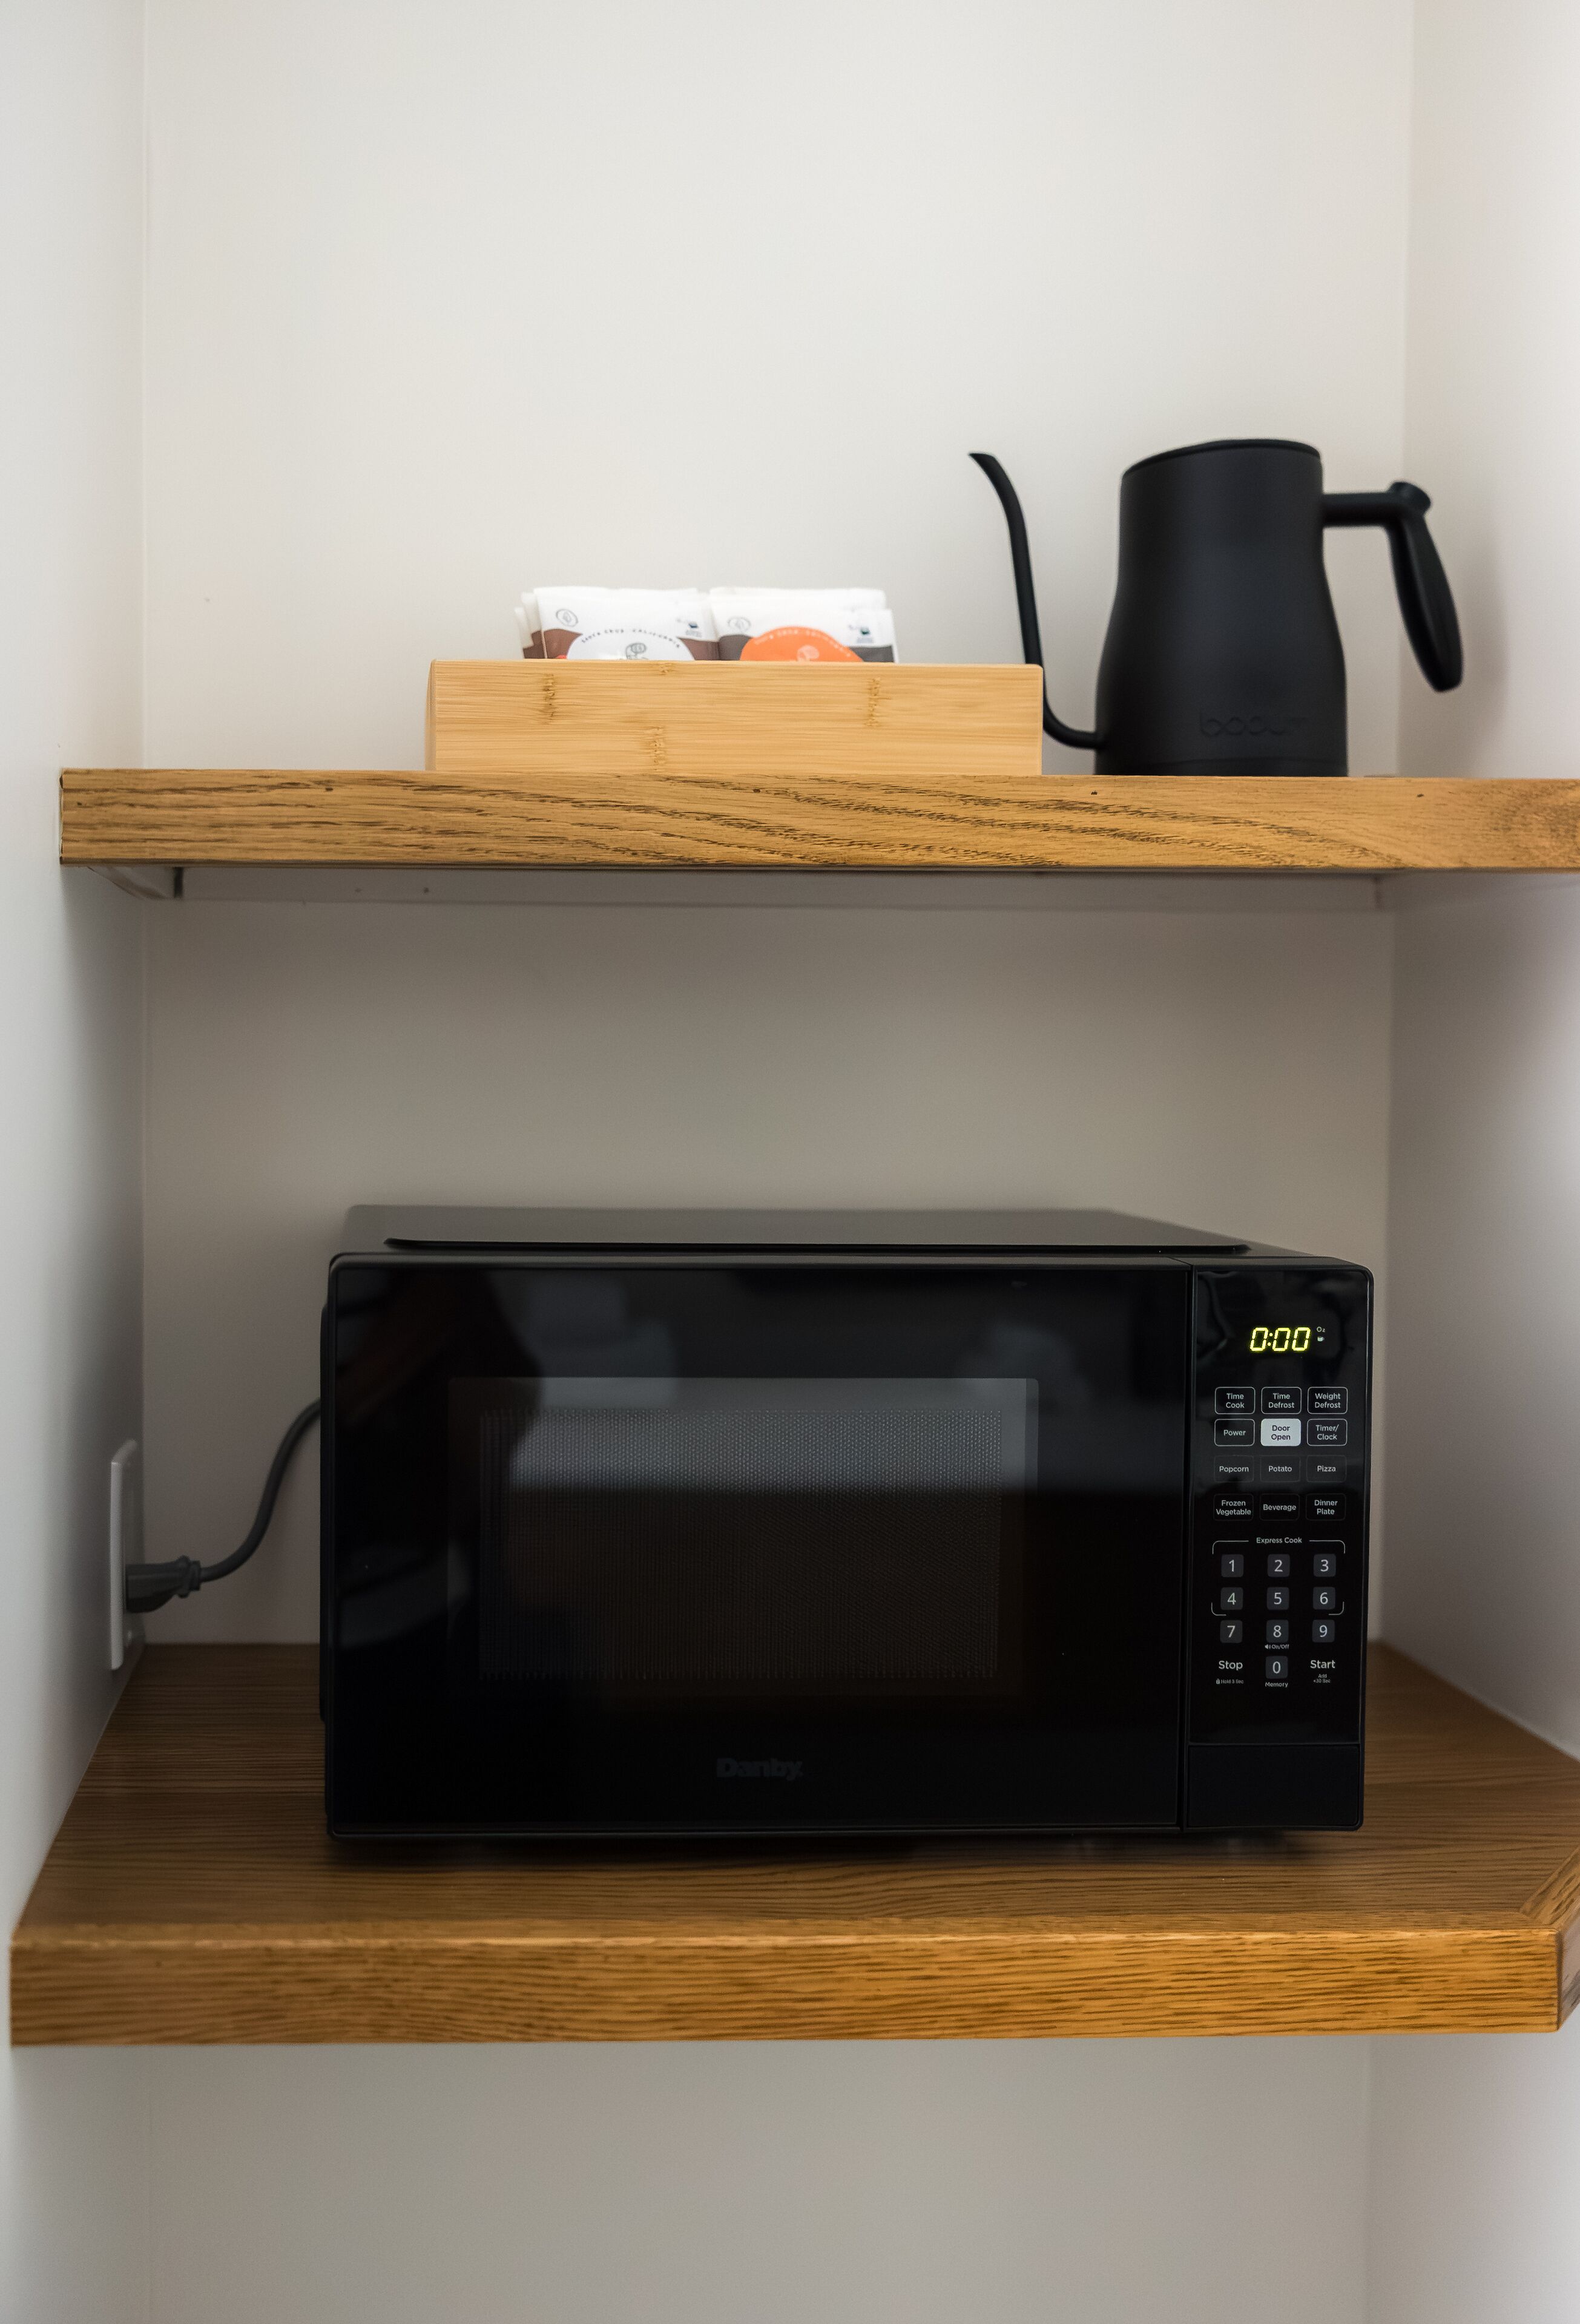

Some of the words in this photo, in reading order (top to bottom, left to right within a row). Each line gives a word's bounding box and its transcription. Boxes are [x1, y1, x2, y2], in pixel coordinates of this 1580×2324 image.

[1249, 1327, 1311, 1352] 0:00
[1315, 1424, 1340, 1433] Timer/
[1271, 1433, 1291, 1442] Open
[1219, 1465, 1249, 1474] Popcorn
[1216, 1508, 1251, 1517] Vegetable
[1263, 1503, 1297, 1512] Beverage
[1229, 1559, 1234, 1572] 1
[1274, 1559, 1283, 1572] 2
[1320, 1559, 1329, 1572] 3
[1227, 1592, 1237, 1605] 4
[1274, 1592, 1282, 1605] 5
[1320, 1592, 1328, 1605] 6
[1227, 1625, 1236, 1638] 7
[1273, 1625, 1282, 1638] 8
[1319, 1624, 1328, 1638] 9
[1218, 1660, 1243, 1671] Stop
[1272, 1661, 1281, 1674] 0
[1310, 1659, 1336, 1669] Start
[716, 1758, 801, 1781] Danby
